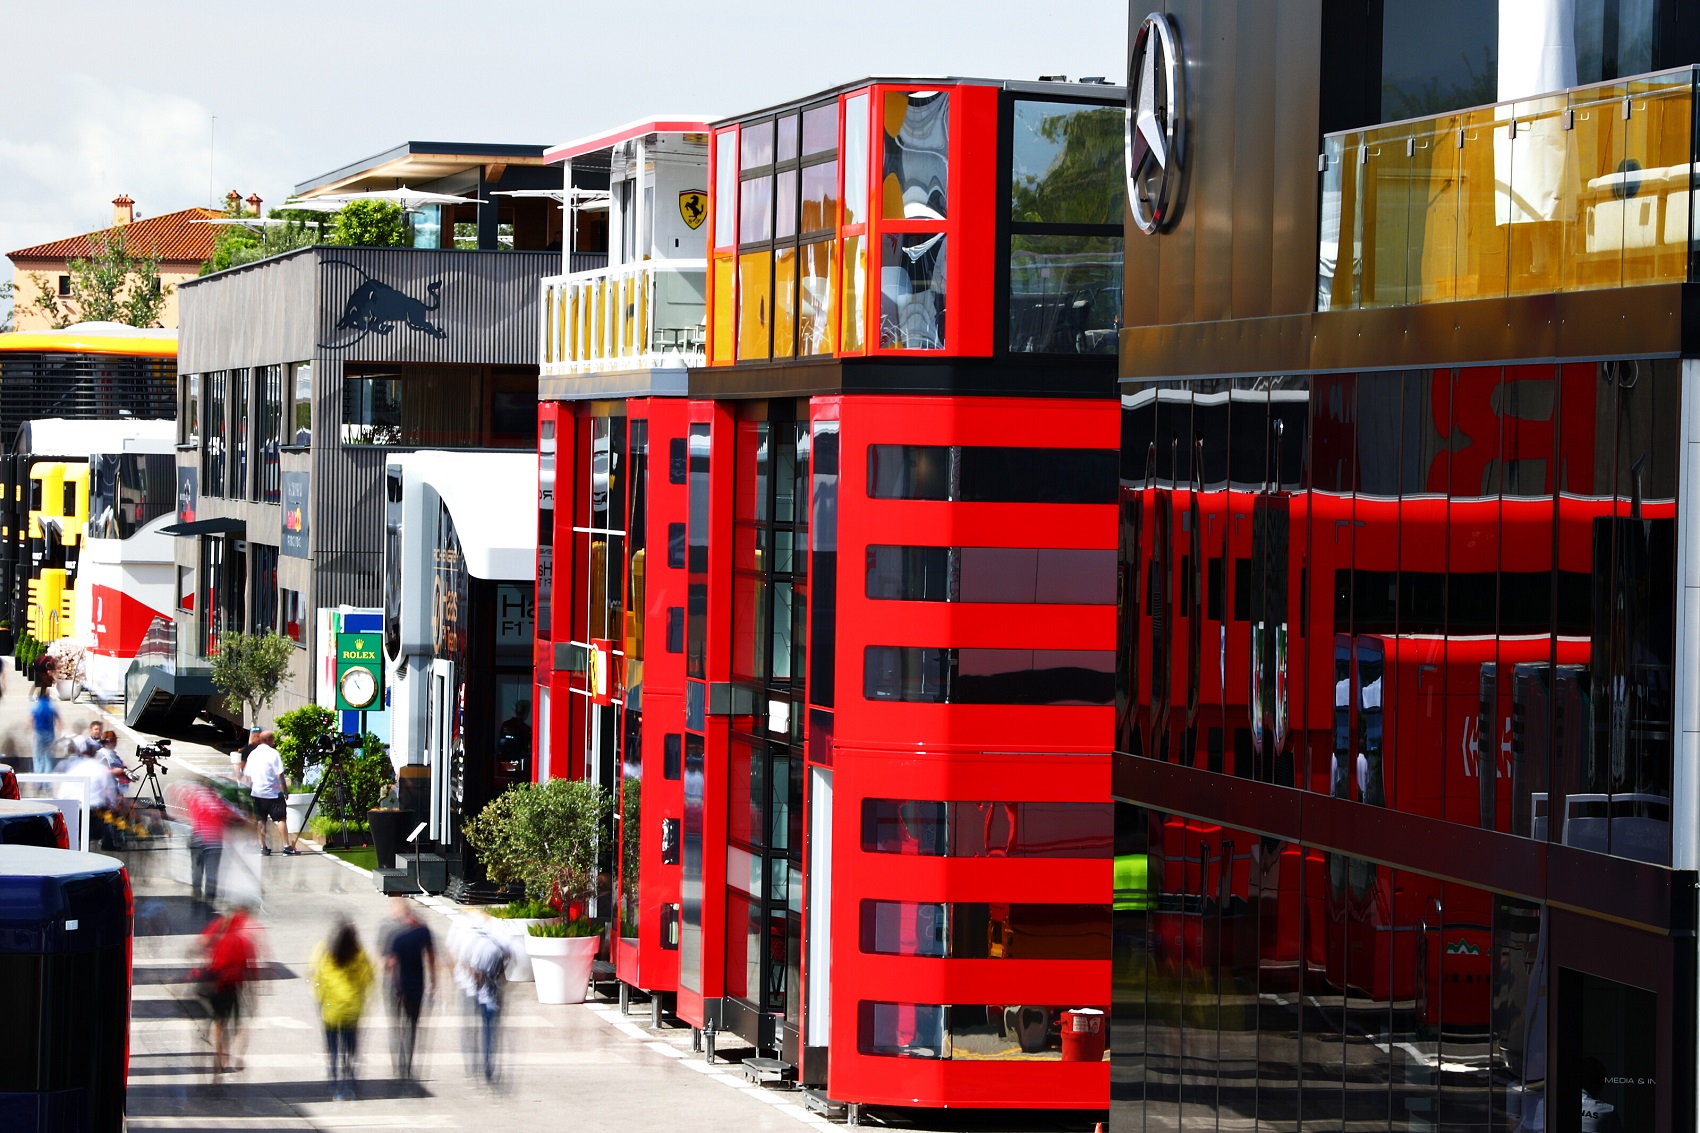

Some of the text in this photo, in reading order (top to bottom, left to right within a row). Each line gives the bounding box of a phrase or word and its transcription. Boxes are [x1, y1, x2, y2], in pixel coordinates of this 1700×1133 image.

[502, 621, 521, 636] F1
[343, 651, 375, 659] ROLEX
[1637, 1077, 1645, 1085] &
